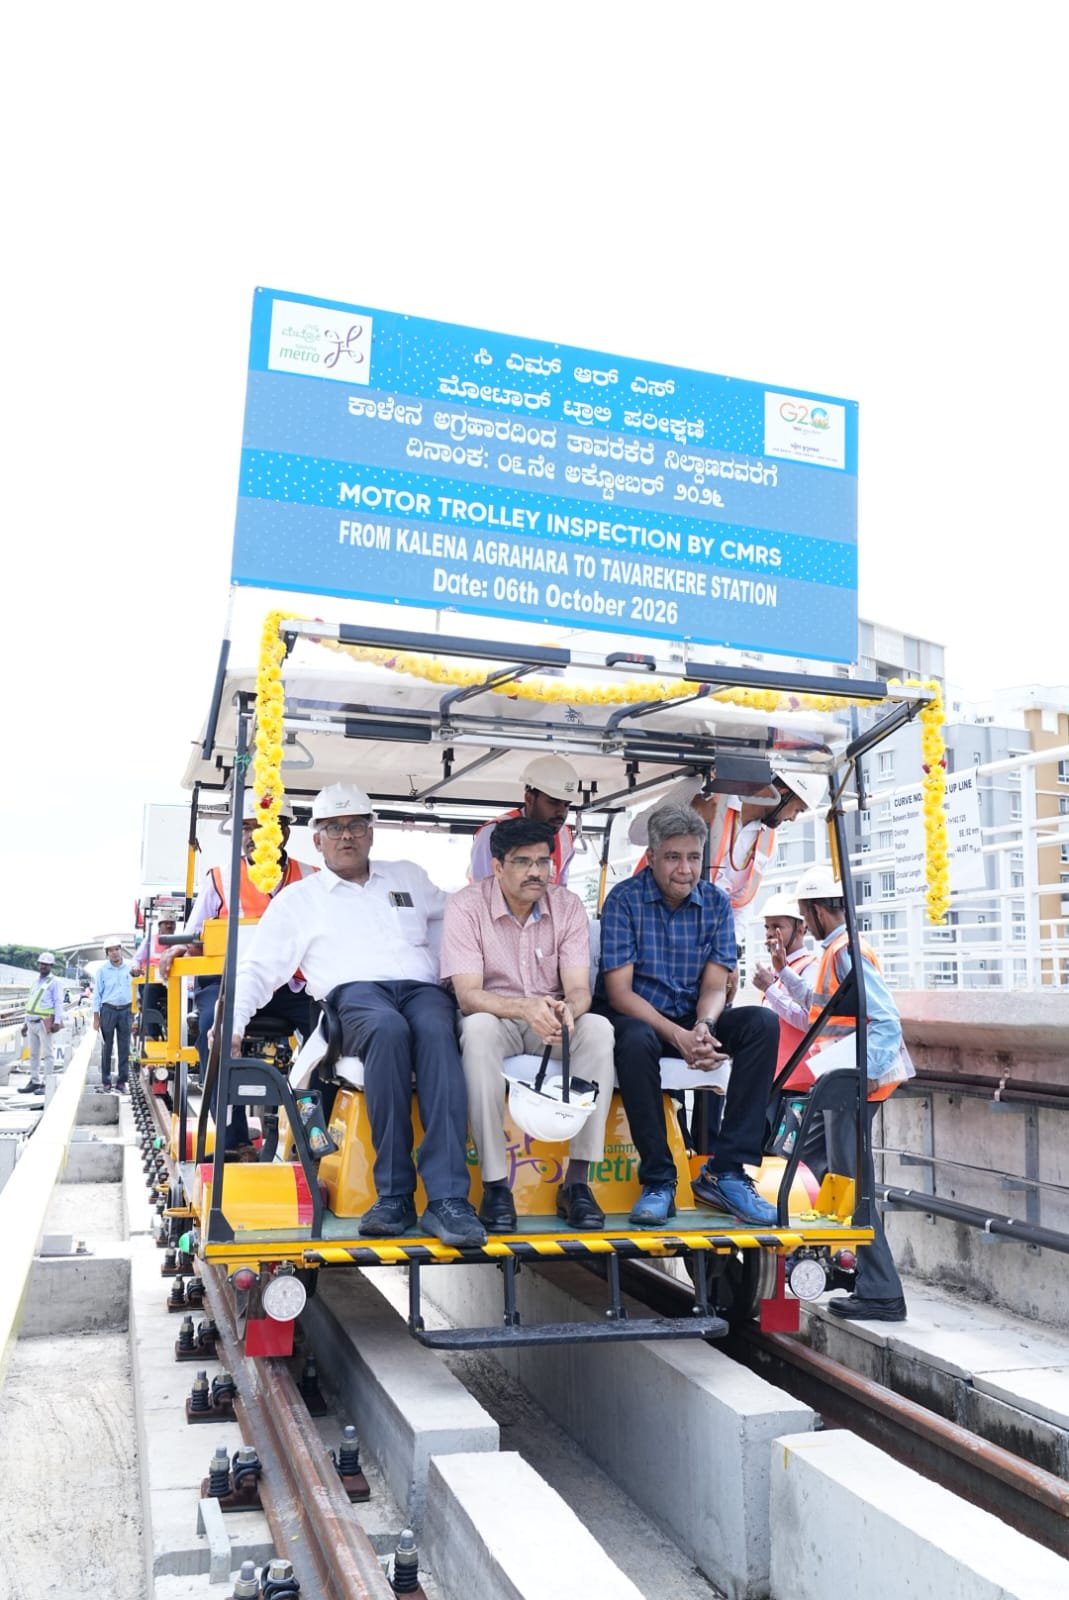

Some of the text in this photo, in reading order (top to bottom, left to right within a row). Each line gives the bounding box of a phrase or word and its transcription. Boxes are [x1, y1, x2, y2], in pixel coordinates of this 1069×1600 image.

[279, 346, 320, 363] metro
[473, 347, 676, 397] ಸಿ ಎಮ್ ಆರ್ ಎಸ್
[438, 374, 706, 446] ಮೋಟಾರ್ ಟ್ರಾಲಿ ಪರೀಕ್ಷಣೆ
[347, 396, 424, 426] ಕಾಳೇನ
[433, 409, 558, 449] ಅಗ್ರಹಾರದಿಂದ
[566, 433, 655, 465] ತಾವರೆಕೆರೆ
[663, 449, 778, 488] ನಿಲ್ದಾಣದವರೆಗೆ
[405, 437, 489, 469] ದಿನಾಂಕ:
[564, 463, 665, 501] ಅಕ್ಟೋಬರ್
[338, 482, 782, 567] MOTOR TROLLEY INSPECTION BY CMRS
[338, 520, 777, 607] FROM KALENA AGRAHARA TO TAVAREKERE STATION
[433, 568, 488, 598] Date:
[493, 576, 538, 605] 06th
[545, 584, 626, 616] October
[631, 596, 678, 624] 2026
[949, 783, 957, 793] UP
[958, 779, 972, 791] LINE
[588, 1156, 641, 1182] etr
[604, 1143, 637, 1153] amm
